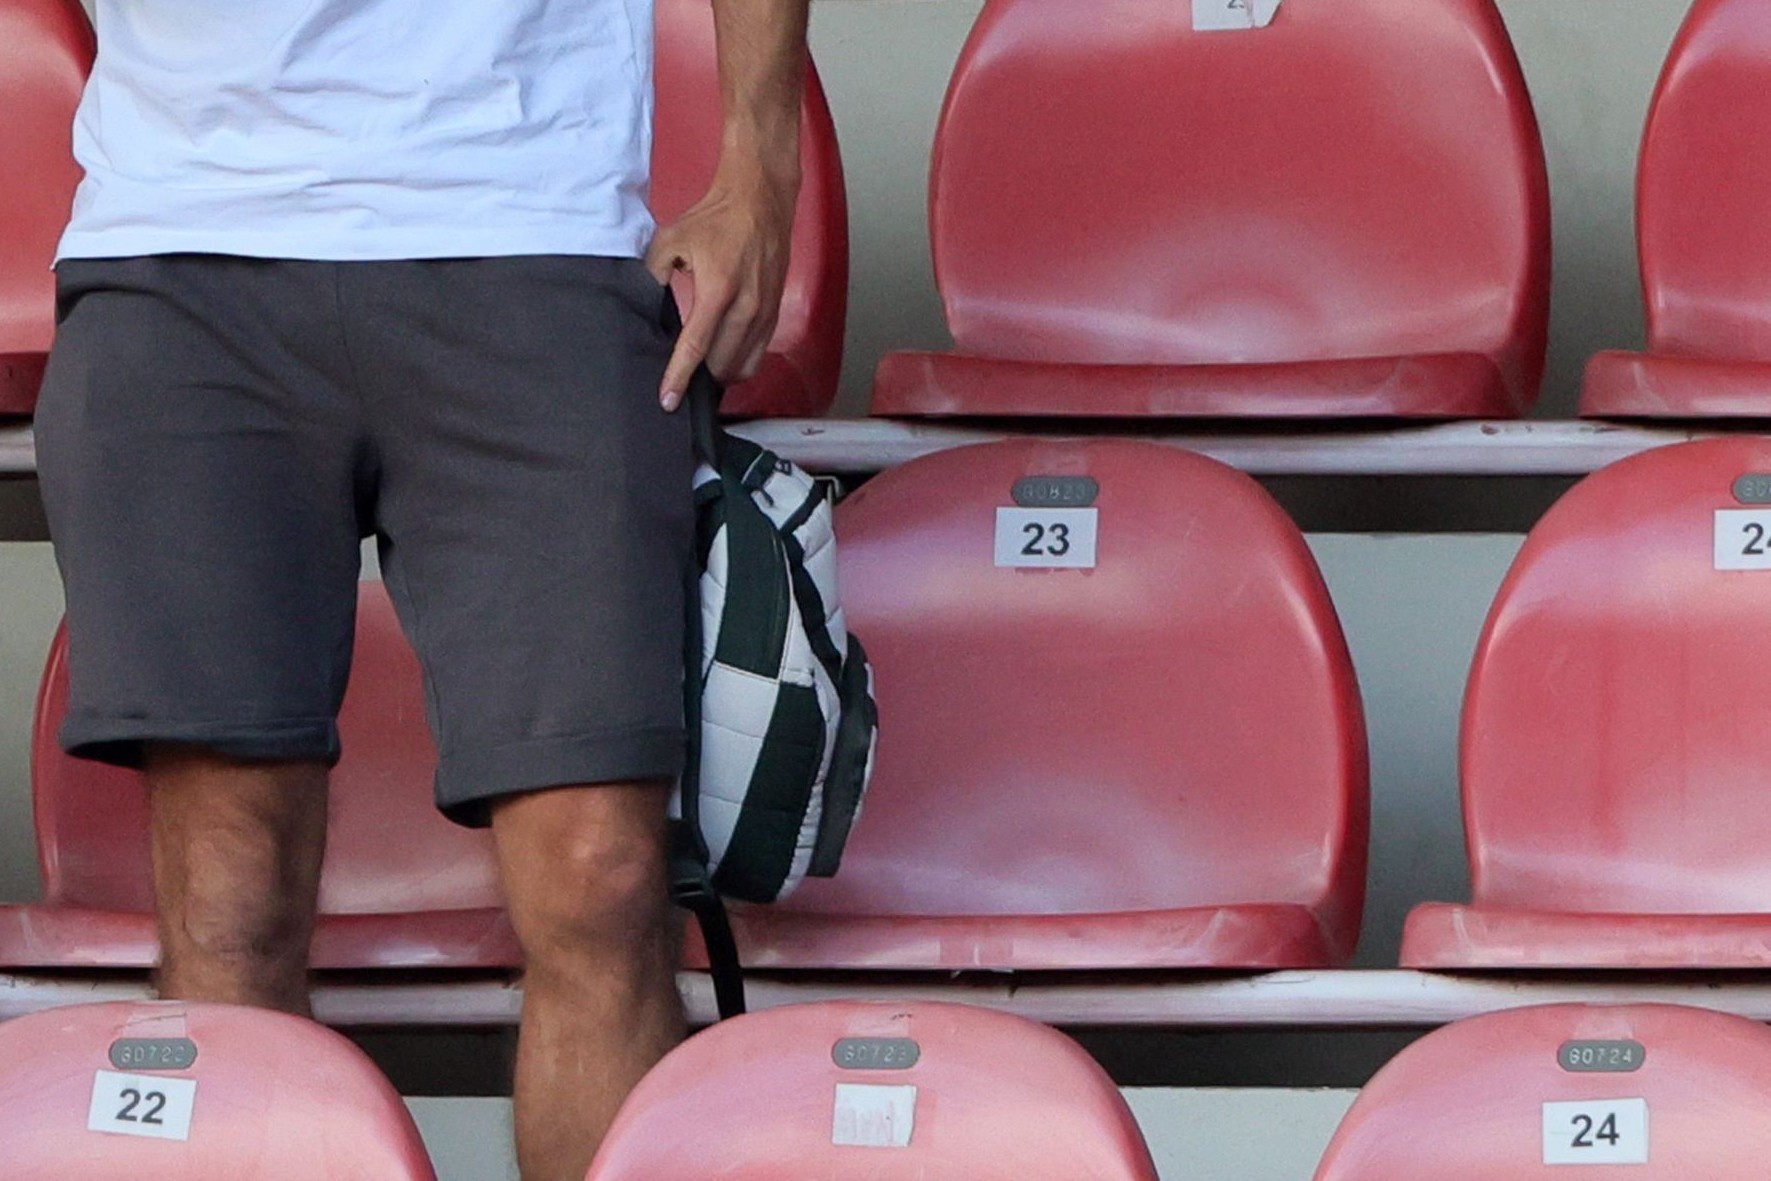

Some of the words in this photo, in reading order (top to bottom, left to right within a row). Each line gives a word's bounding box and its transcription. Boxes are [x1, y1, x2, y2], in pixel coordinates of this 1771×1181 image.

[1021, 522, 1070, 557] 23
[115, 1088, 167, 1125] 22
[1571, 1112, 1620, 1148] 24
